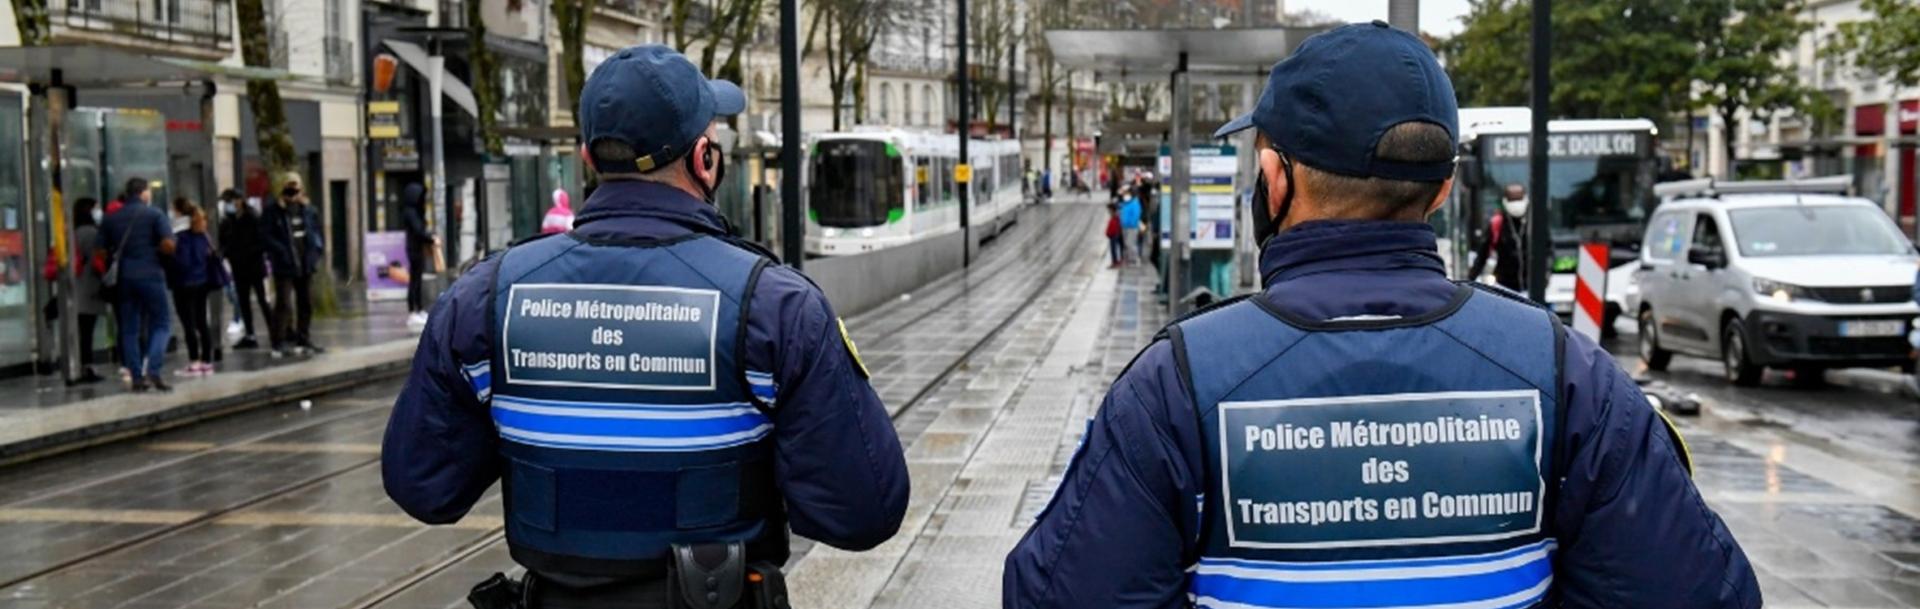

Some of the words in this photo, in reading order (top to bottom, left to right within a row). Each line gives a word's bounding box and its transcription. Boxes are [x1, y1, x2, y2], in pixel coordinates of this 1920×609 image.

[1568, 133, 1636, 155] DOULON
[521, 298, 572, 318] Police
[575, 300, 701, 323] Métropolitaine
[592, 326, 623, 346] des
[511, 349, 601, 371] Transports
[605, 356, 625, 372] en
[629, 353, 706, 374] Commun
[1245, 423, 1325, 452] Police
[1330, 415, 1521, 448] Métropolitaine
[1361, 457, 1409, 485] des
[1237, 496, 1379, 526] Transports
[1384, 497, 1416, 520] en
[1422, 490, 1534, 519] Commun
